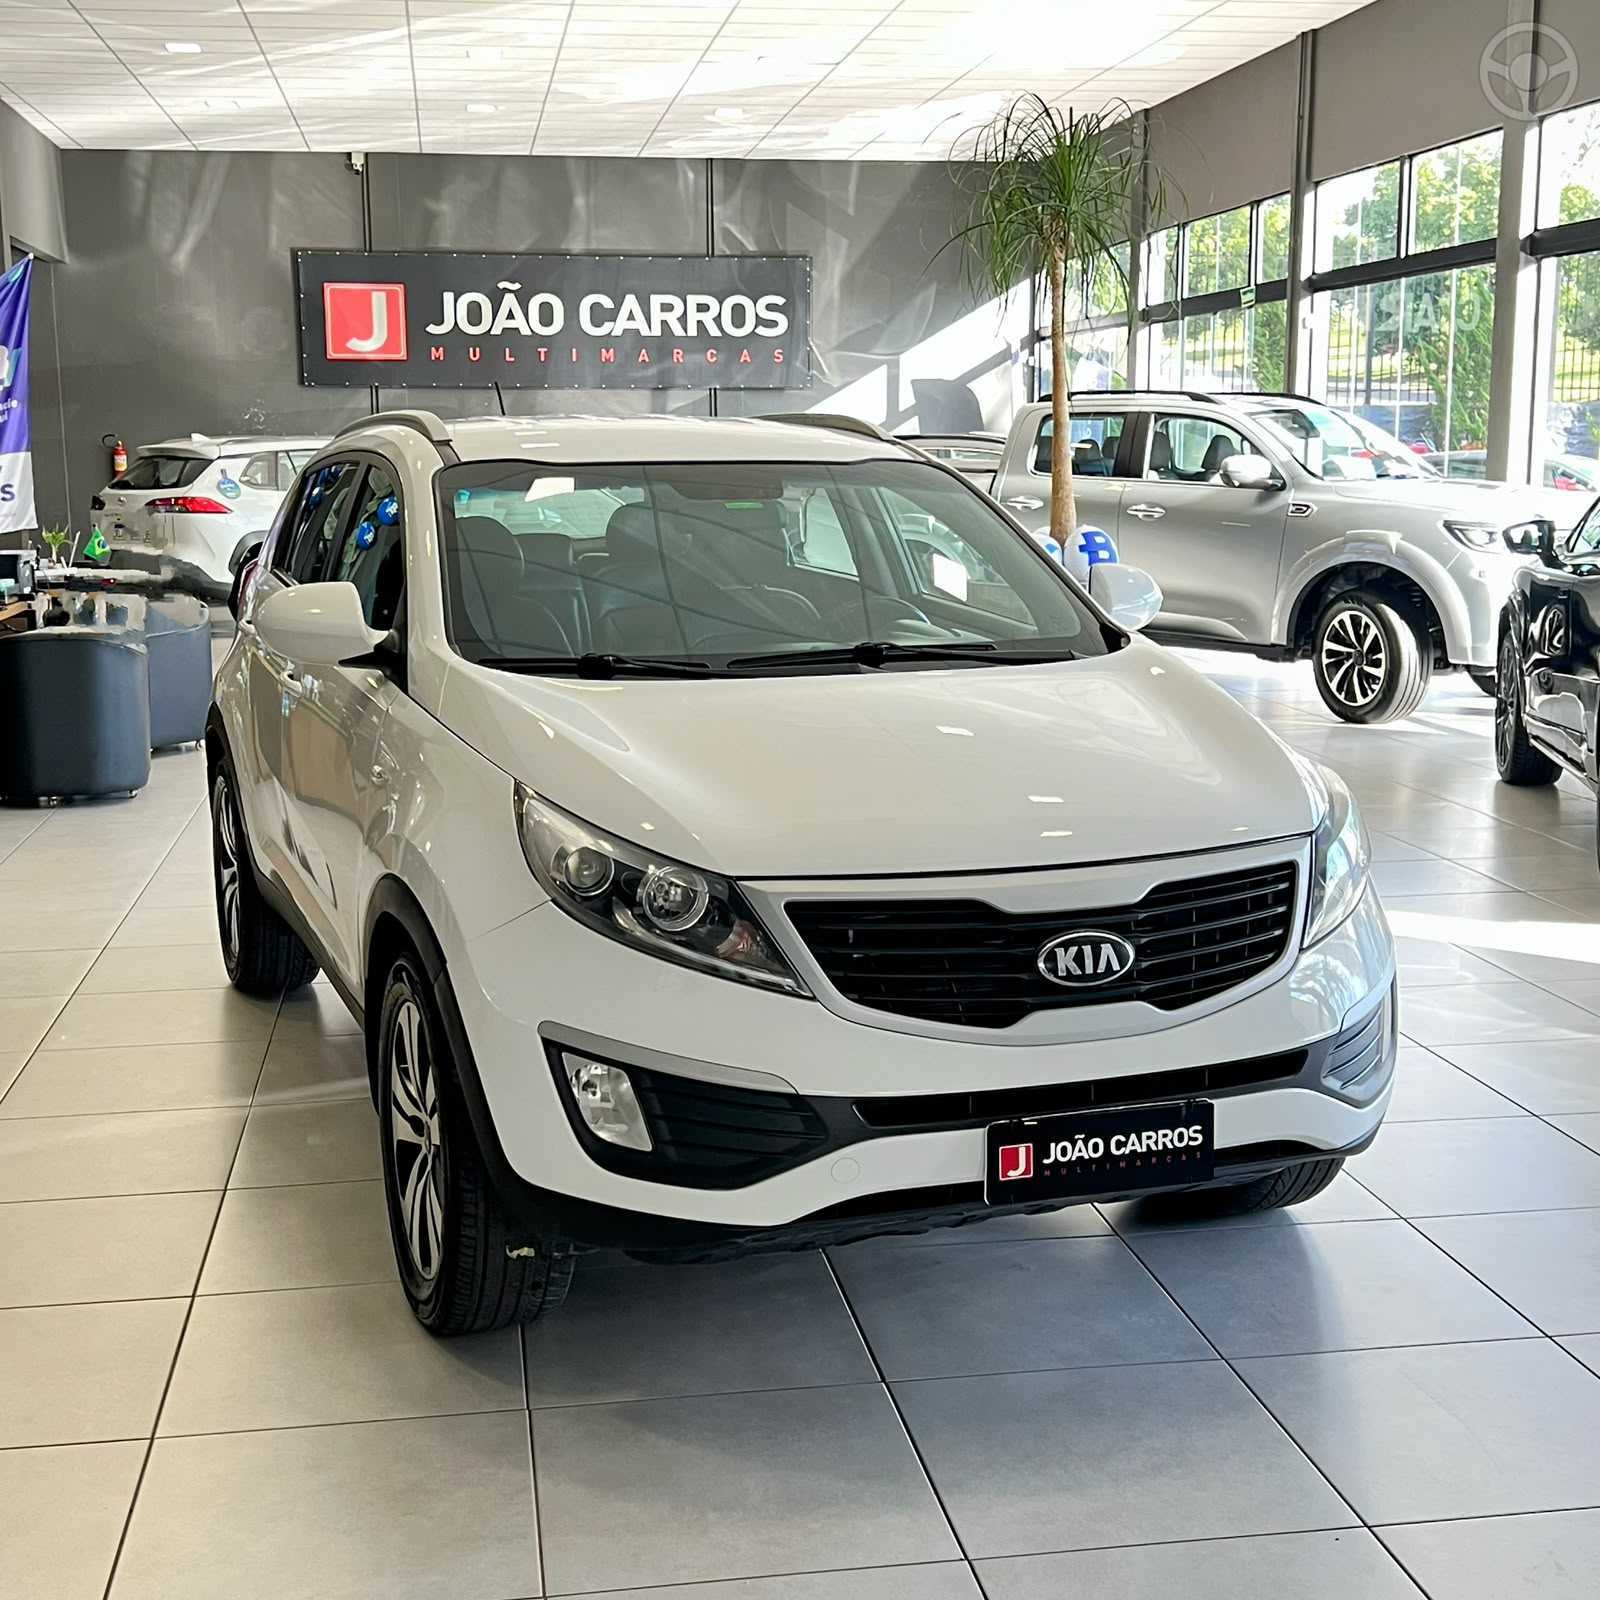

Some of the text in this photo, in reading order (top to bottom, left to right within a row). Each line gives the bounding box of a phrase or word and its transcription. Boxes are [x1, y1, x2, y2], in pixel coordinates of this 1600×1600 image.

[345, 290, 387, 352] J
[425, 280, 789, 338] JOÃO CARROS
[429, 346, 785, 364] MULTIMARCAS
[1054, 943, 1121, 977] KIA
[1042, 1125, 1203, 1164] JOÃO CARROS
[1043, 1151, 1202, 1177] MULTIMARCAS
